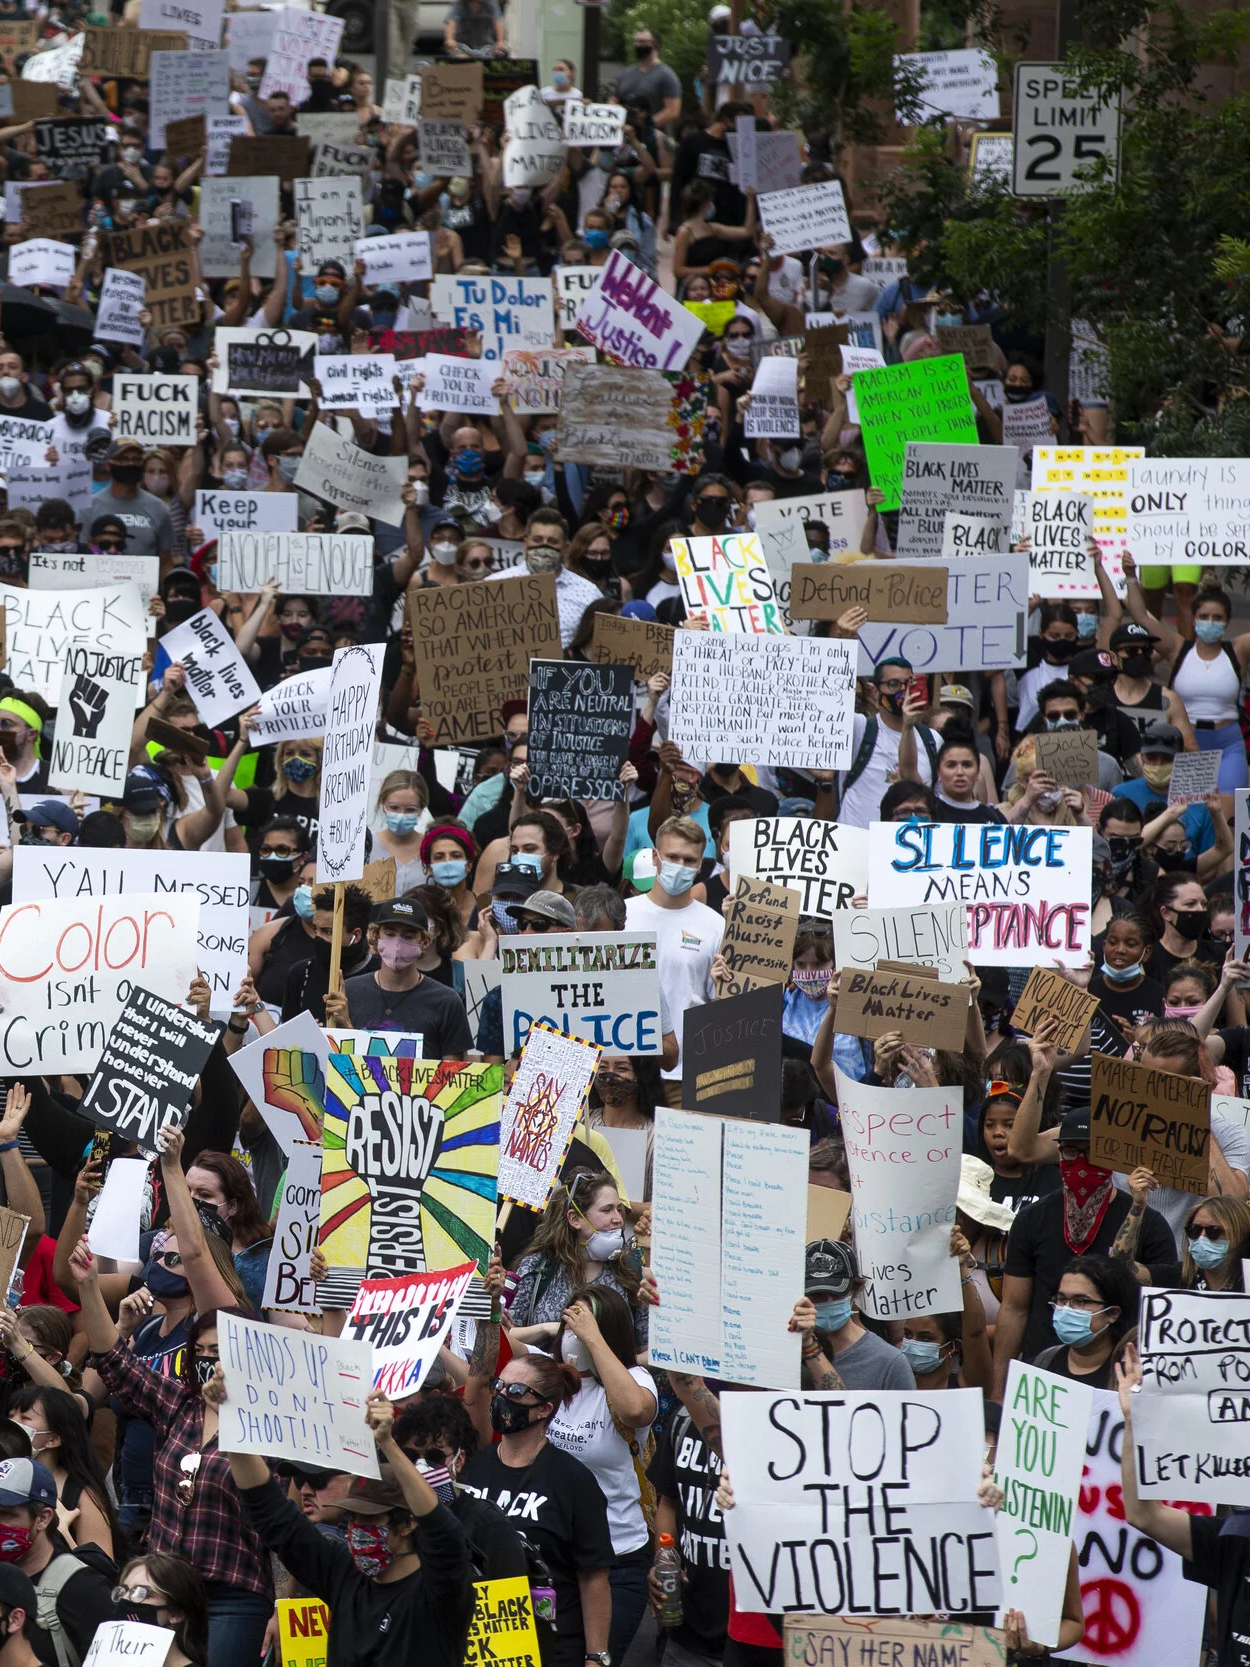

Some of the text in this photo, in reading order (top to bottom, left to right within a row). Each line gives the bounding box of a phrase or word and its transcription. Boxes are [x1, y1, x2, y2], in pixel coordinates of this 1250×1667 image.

[716, 35, 777, 56] JUST
[718, 60, 782, 82] NICE
[571, 107, 618, 120] FUCK
[1034, 107, 1102, 127] LIMIT
[36, 117, 108, 146] JESUS
[320, 144, 369, 165] FUCK
[1026, 135, 1106, 180] 25
[112, 224, 187, 261] BLACK
[439, 364, 480, 380] CHECK
[443, 379, 475, 393] YOUR
[122, 383, 188, 400] FUCK
[425, 389, 491, 408] PRIVILEGE
[120, 411, 190, 436] RACISM
[905, 461, 979, 478] BLACK LIVES
[201, 490, 258, 514] Keep
[951, 478, 1003, 496] MATTER
[1132, 492, 1187, 514] ONLY
[1033, 500, 1087, 525] BLACK
[1034, 525, 1081, 547] LIVES
[673, 537, 764, 576] BLACK
[1029, 551, 1086, 571] MATTER
[417, 579, 542, 615] RACISM IS
[683, 567, 773, 608] LIVES
[800, 573, 943, 609] Defund Police
[4, 594, 131, 630] BLACK
[419, 599, 555, 638] SO AMERICAN
[420, 615, 559, 660] THAT WHEN YOU
[858, 624, 1015, 667] VOTE
[433, 652, 515, 691] protest
[537, 666, 614, 695] IF YOU
[533, 690, 632, 711] ARE NEUTRAL
[530, 729, 604, 751] OF INJUSTICE
[1039, 736, 1094, 757] Black
[51, 741, 124, 780] NO PEACE
[1041, 748, 1089, 769] Lives
[324, 766, 366, 808] BREONNA
[529, 774, 624, 799] OPPRESSOR
[753, 818, 839, 851] BLACK
[891, 822, 1071, 873] SILENCE
[756, 846, 828, 875] LIVES
[735, 874, 789, 910] Defund
[924, 870, 1031, 903] MEANS
[731, 902, 783, 930] Racist
[725, 927, 784, 949] Abusive
[501, 942, 657, 974] DEMILITARIZE
[721, 942, 789, 973] Oppressive
[550, 982, 605, 1008] THE
[849, 974, 951, 1007] Black Lives
[1026, 974, 1099, 1022] NO JUSTICE
[862, 994, 936, 1023] Matter
[116, 1022, 158, 1048] never
[513, 1008, 659, 1052] POLICE
[102, 1051, 168, 1090] however
[1094, 1059, 1210, 1109] MAKE AMERICA
[516, 1101, 558, 1133] THEIR
[1093, 1098, 1210, 1158] NOT RACIST
[351, 1090, 445, 1179] RESIST
[505, 1132, 553, 1173] NAMES
[862, 1249, 913, 1283] Lives
[862, 1283, 937, 1315] Matter
[349, 1299, 454, 1349] THIS IS
[228, 1324, 328, 1399] HANDS UP
[246, 1383, 335, 1424] DON'T
[1012, 1373, 1069, 1429] ARE
[237, 1406, 332, 1458] SHOOT!!!
[767, 1397, 943, 1482] STOP
[1011, 1418, 1058, 1478] YOU
[803, 1481, 911, 1537] THE
[737, 1531, 1002, 1614] VIOLENCE
[110, 1624, 154, 1657] Their
[483, 1616, 529, 1634] MATTER
